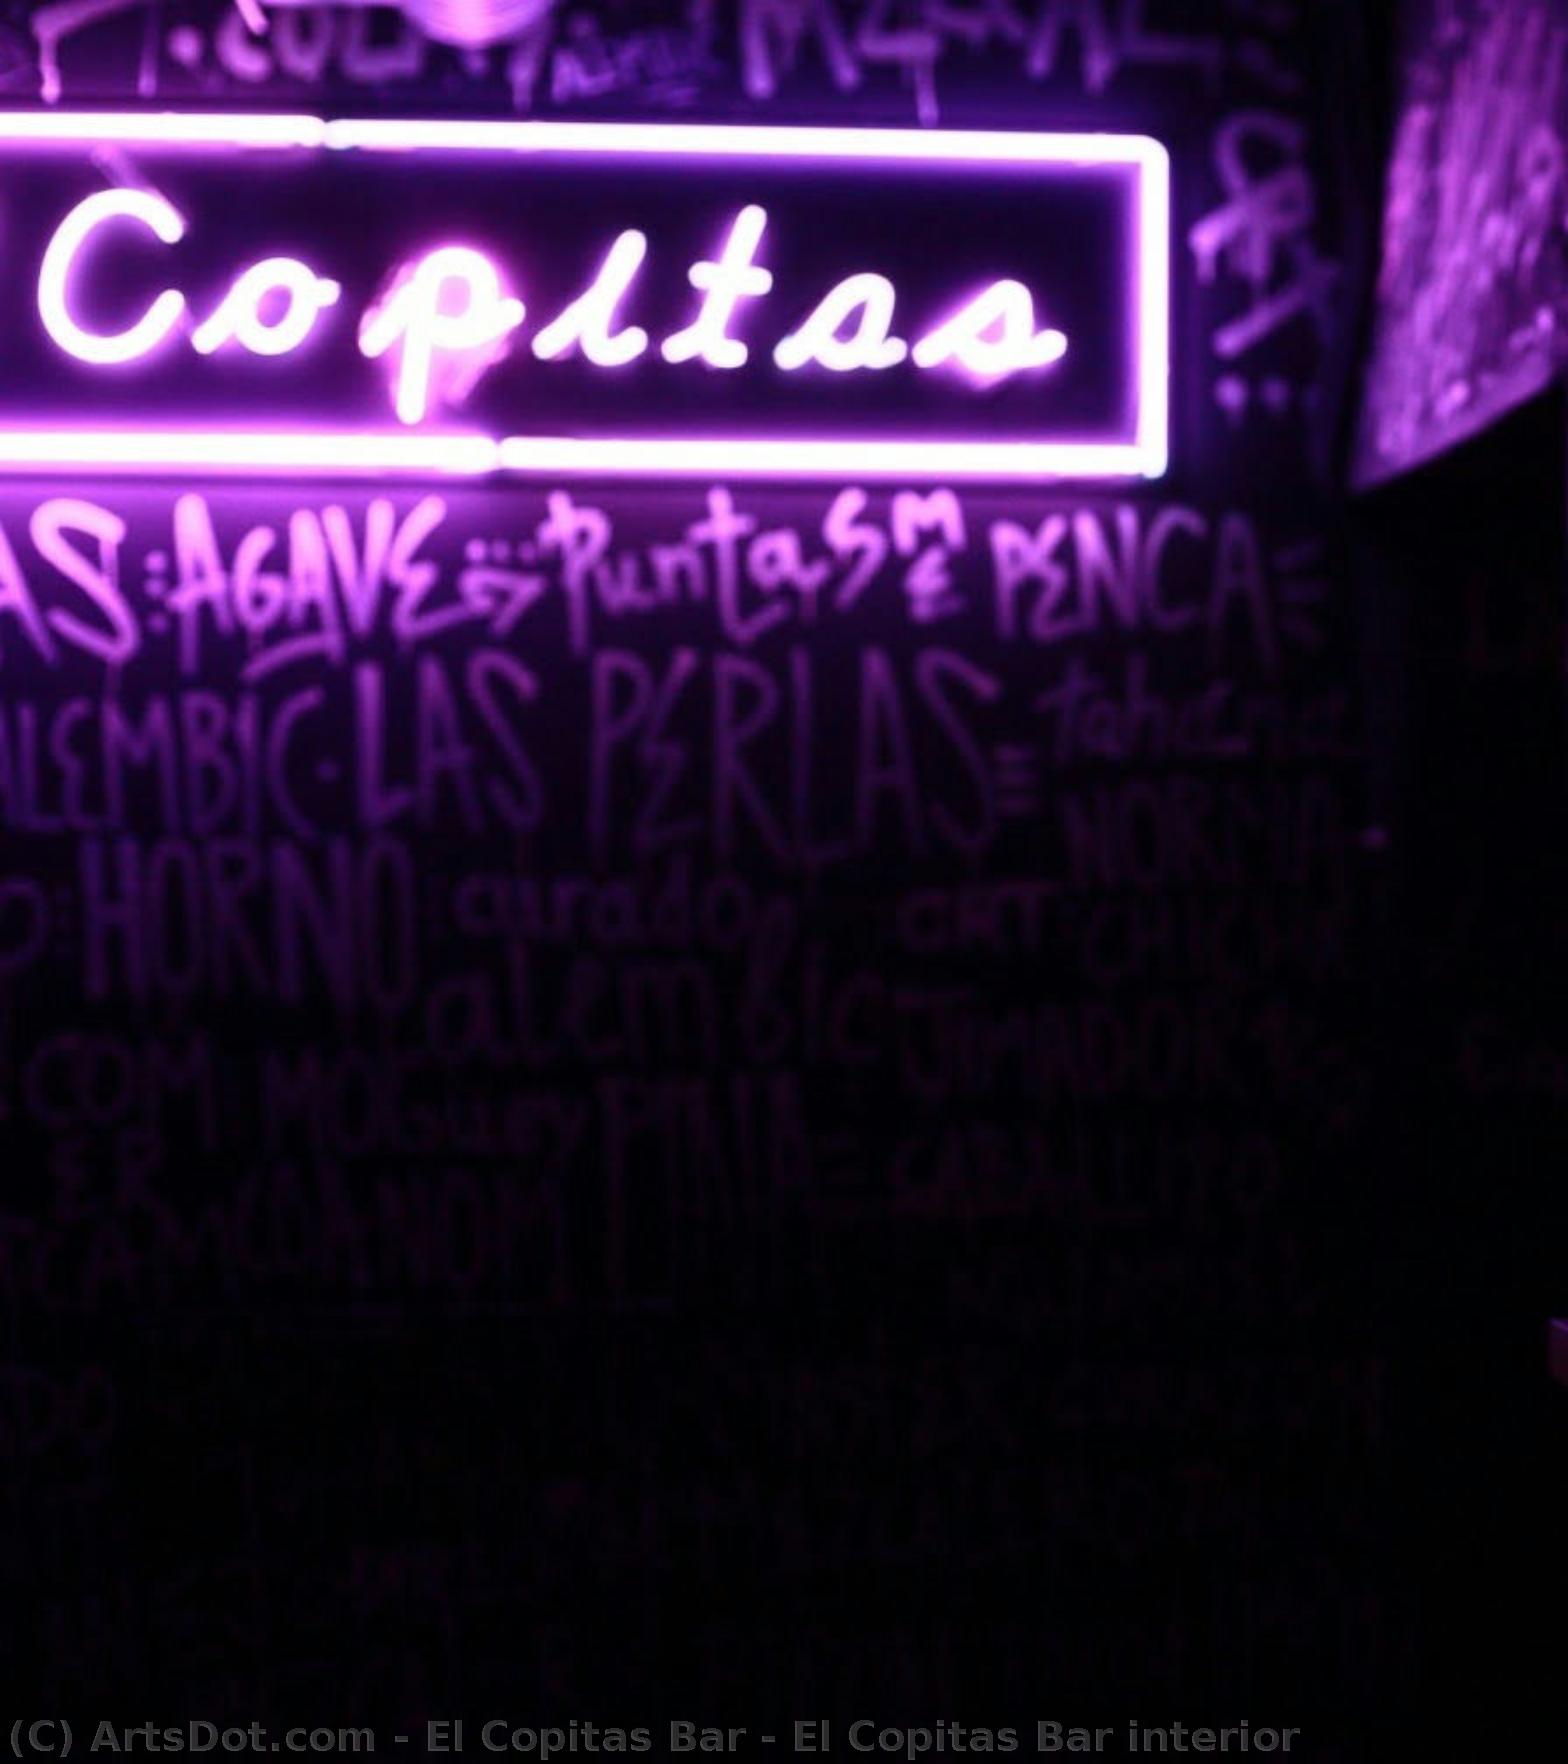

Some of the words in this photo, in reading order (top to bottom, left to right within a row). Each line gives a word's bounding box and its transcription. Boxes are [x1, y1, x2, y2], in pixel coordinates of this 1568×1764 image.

[37, 187, 1068, 425] Copitas
[355, 645, 545, 840] LAS
[80, 835, 416, 1015] HORNO
